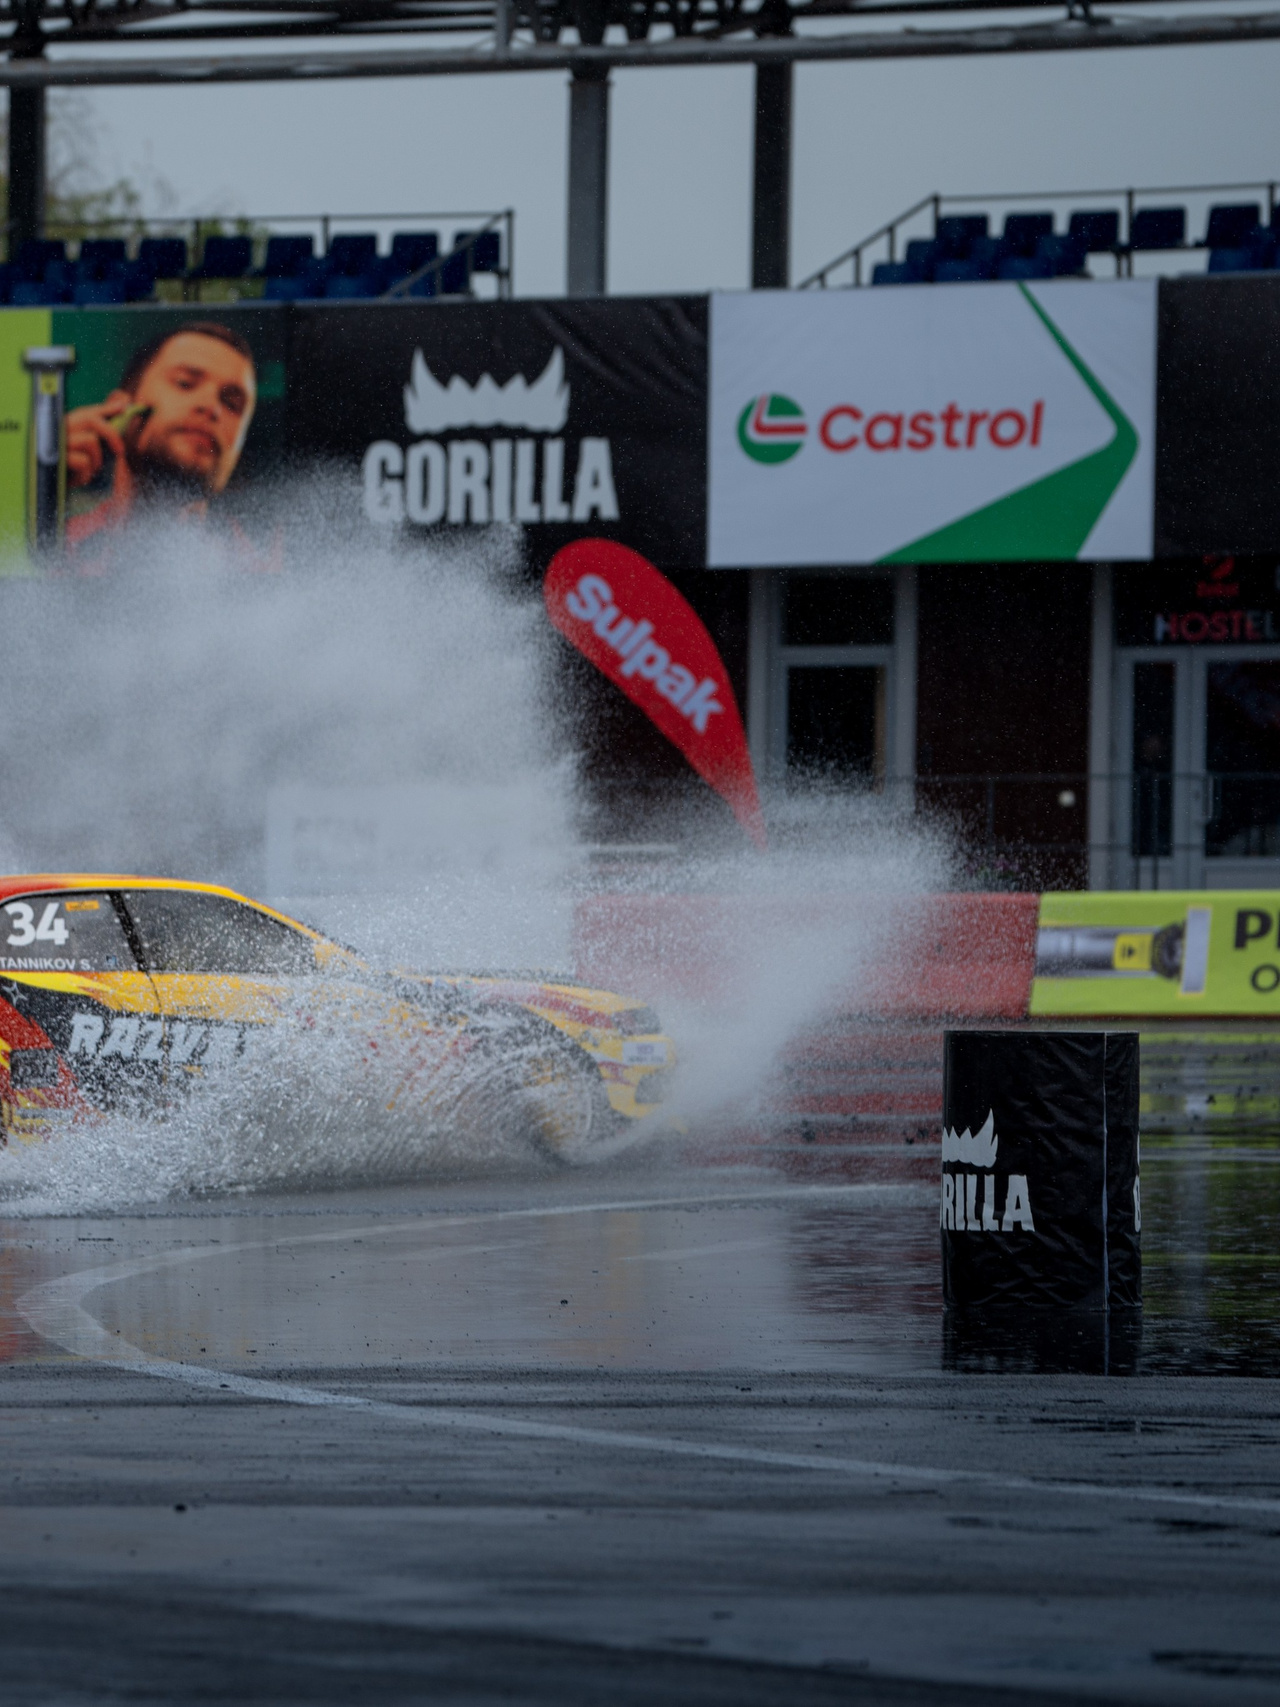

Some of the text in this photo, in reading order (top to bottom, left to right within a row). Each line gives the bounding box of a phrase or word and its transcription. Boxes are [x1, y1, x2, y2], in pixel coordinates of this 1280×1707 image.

[818, 400, 1045, 453] Castrol
[362, 436, 620, 524] GORILLA
[1154, 610, 1277, 643] HOSTEL
[565, 573, 724, 735] Sulpak
[4, 902, 69, 947] 34
[1234, 907, 1280, 951] P
[940, 1173, 1035, 1232] RILLA
